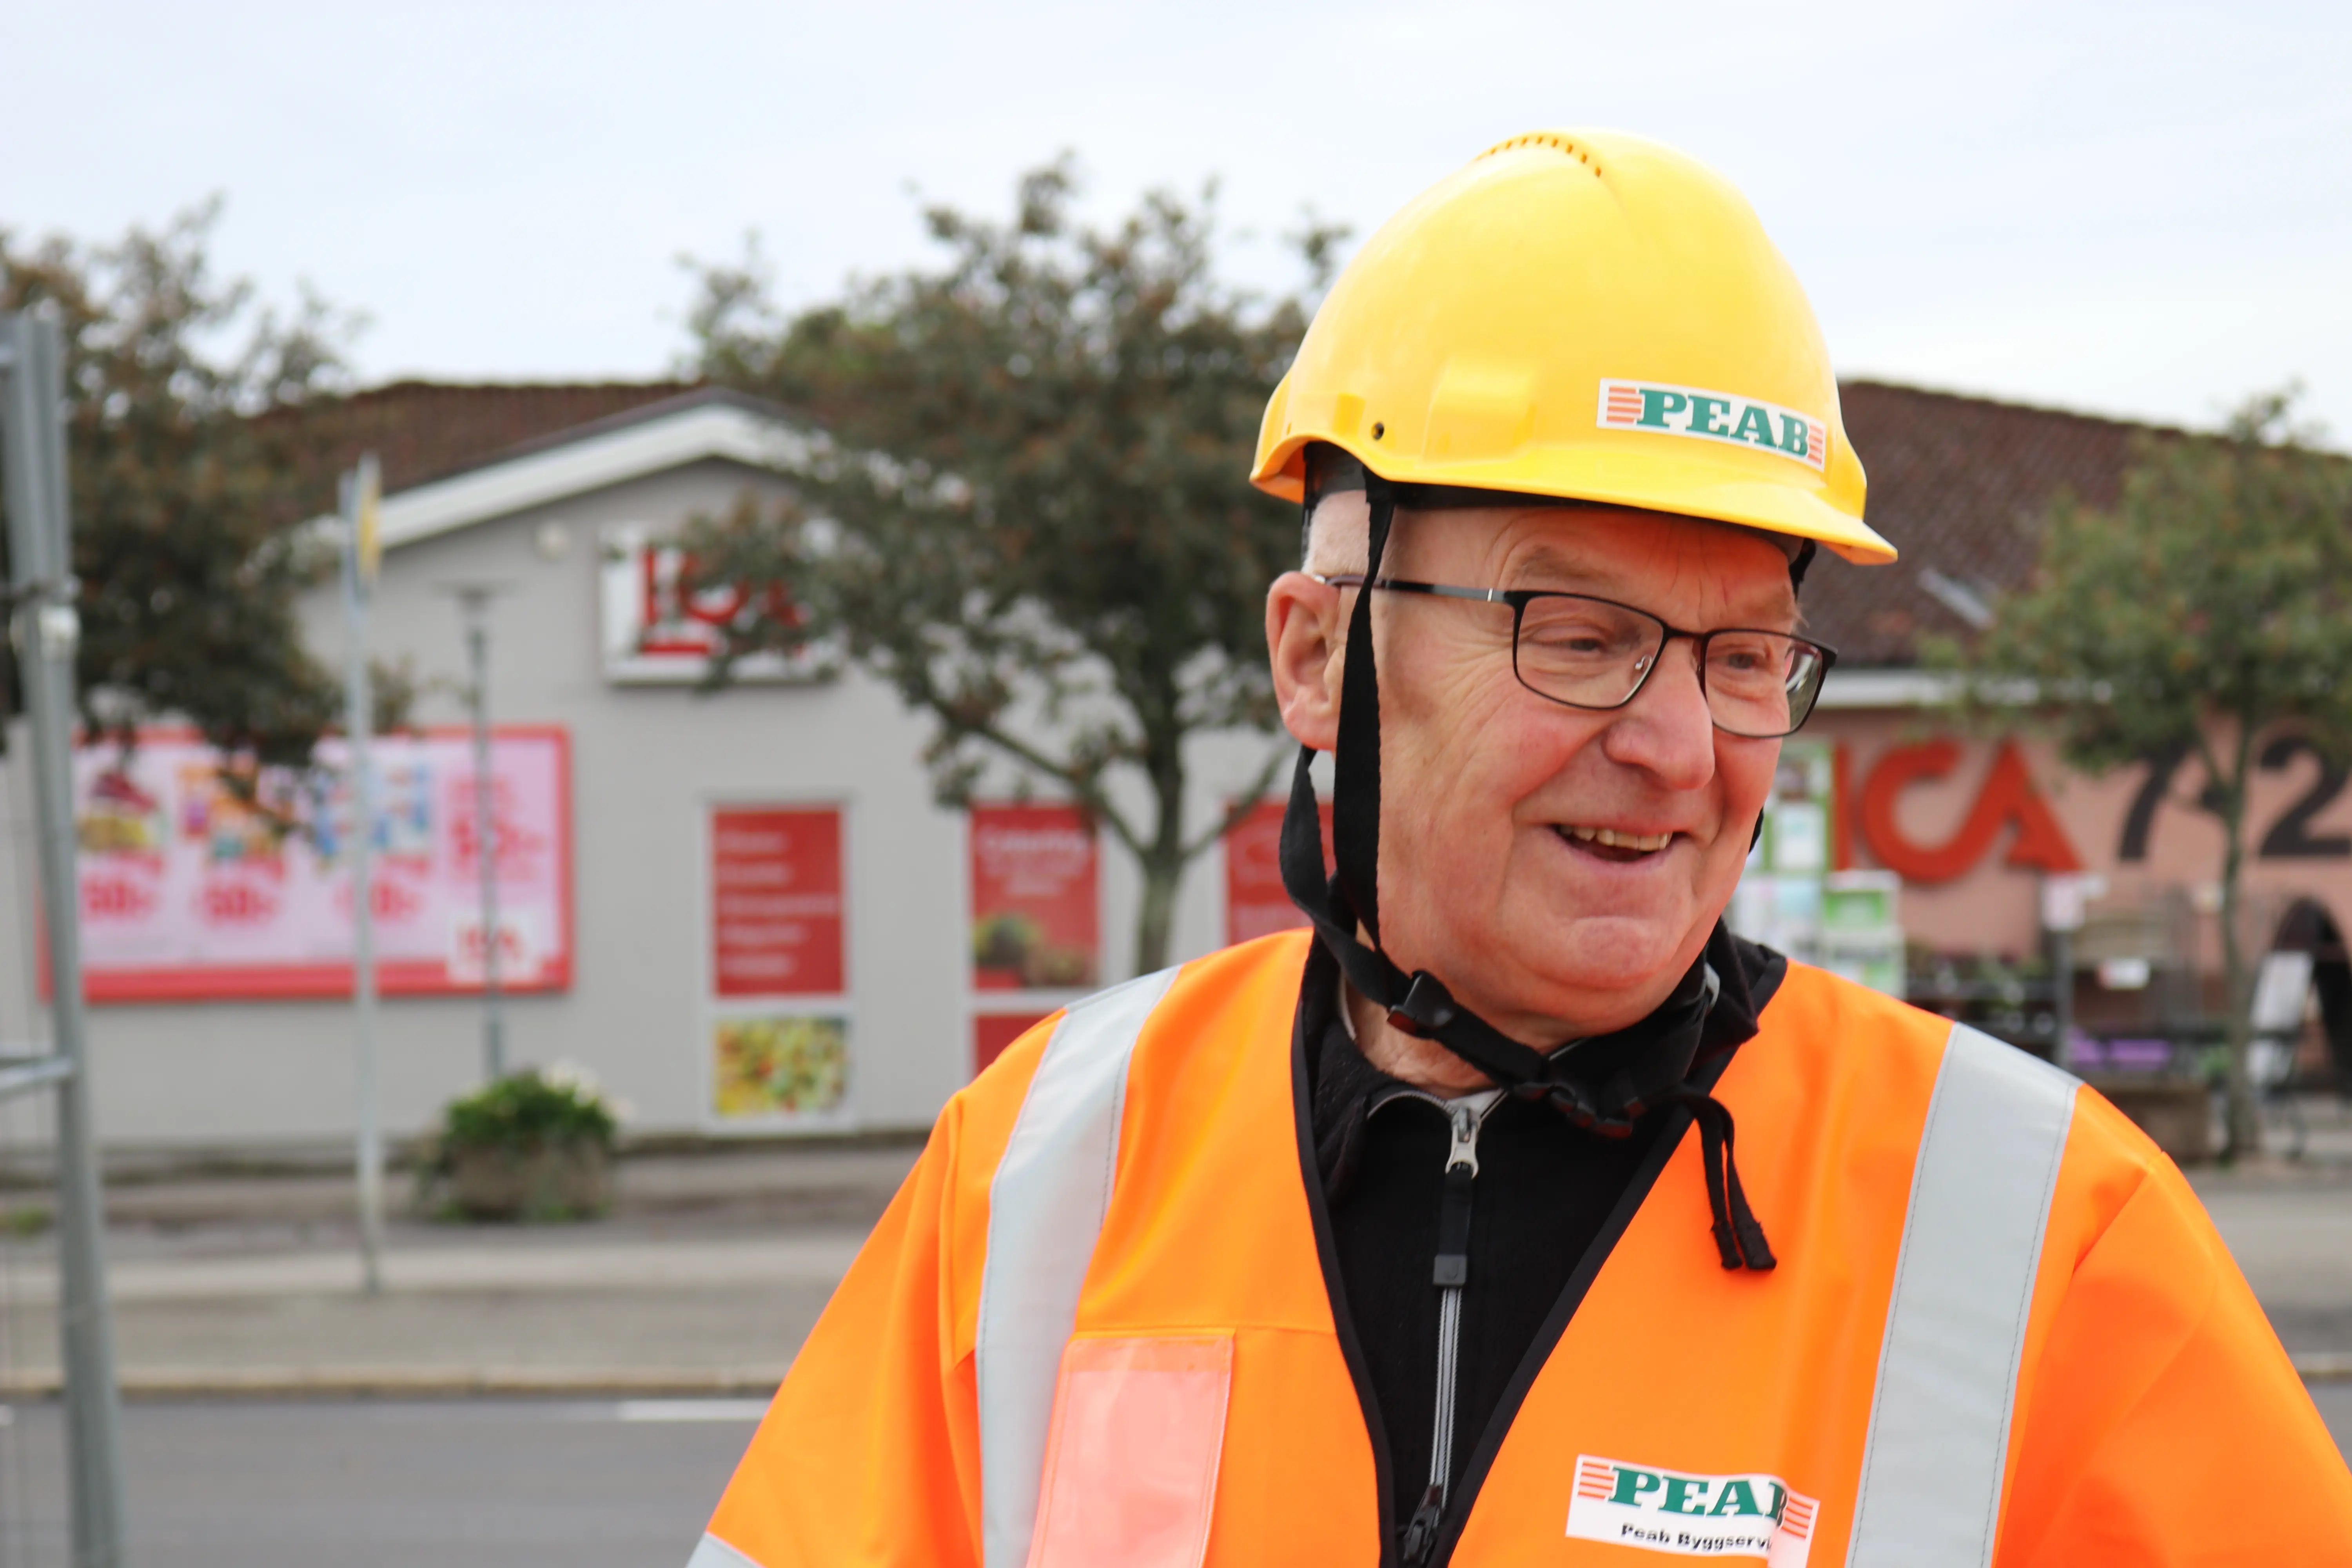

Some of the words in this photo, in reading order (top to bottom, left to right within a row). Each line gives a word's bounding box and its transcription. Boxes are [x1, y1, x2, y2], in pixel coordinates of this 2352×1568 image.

[1636, 388, 1809, 457] PEAB
[1831, 737, 2087, 883] ICA
[1621, 1522, 1670, 1544] Peab
[1677, 1531, 1773, 1551] Byggservi
